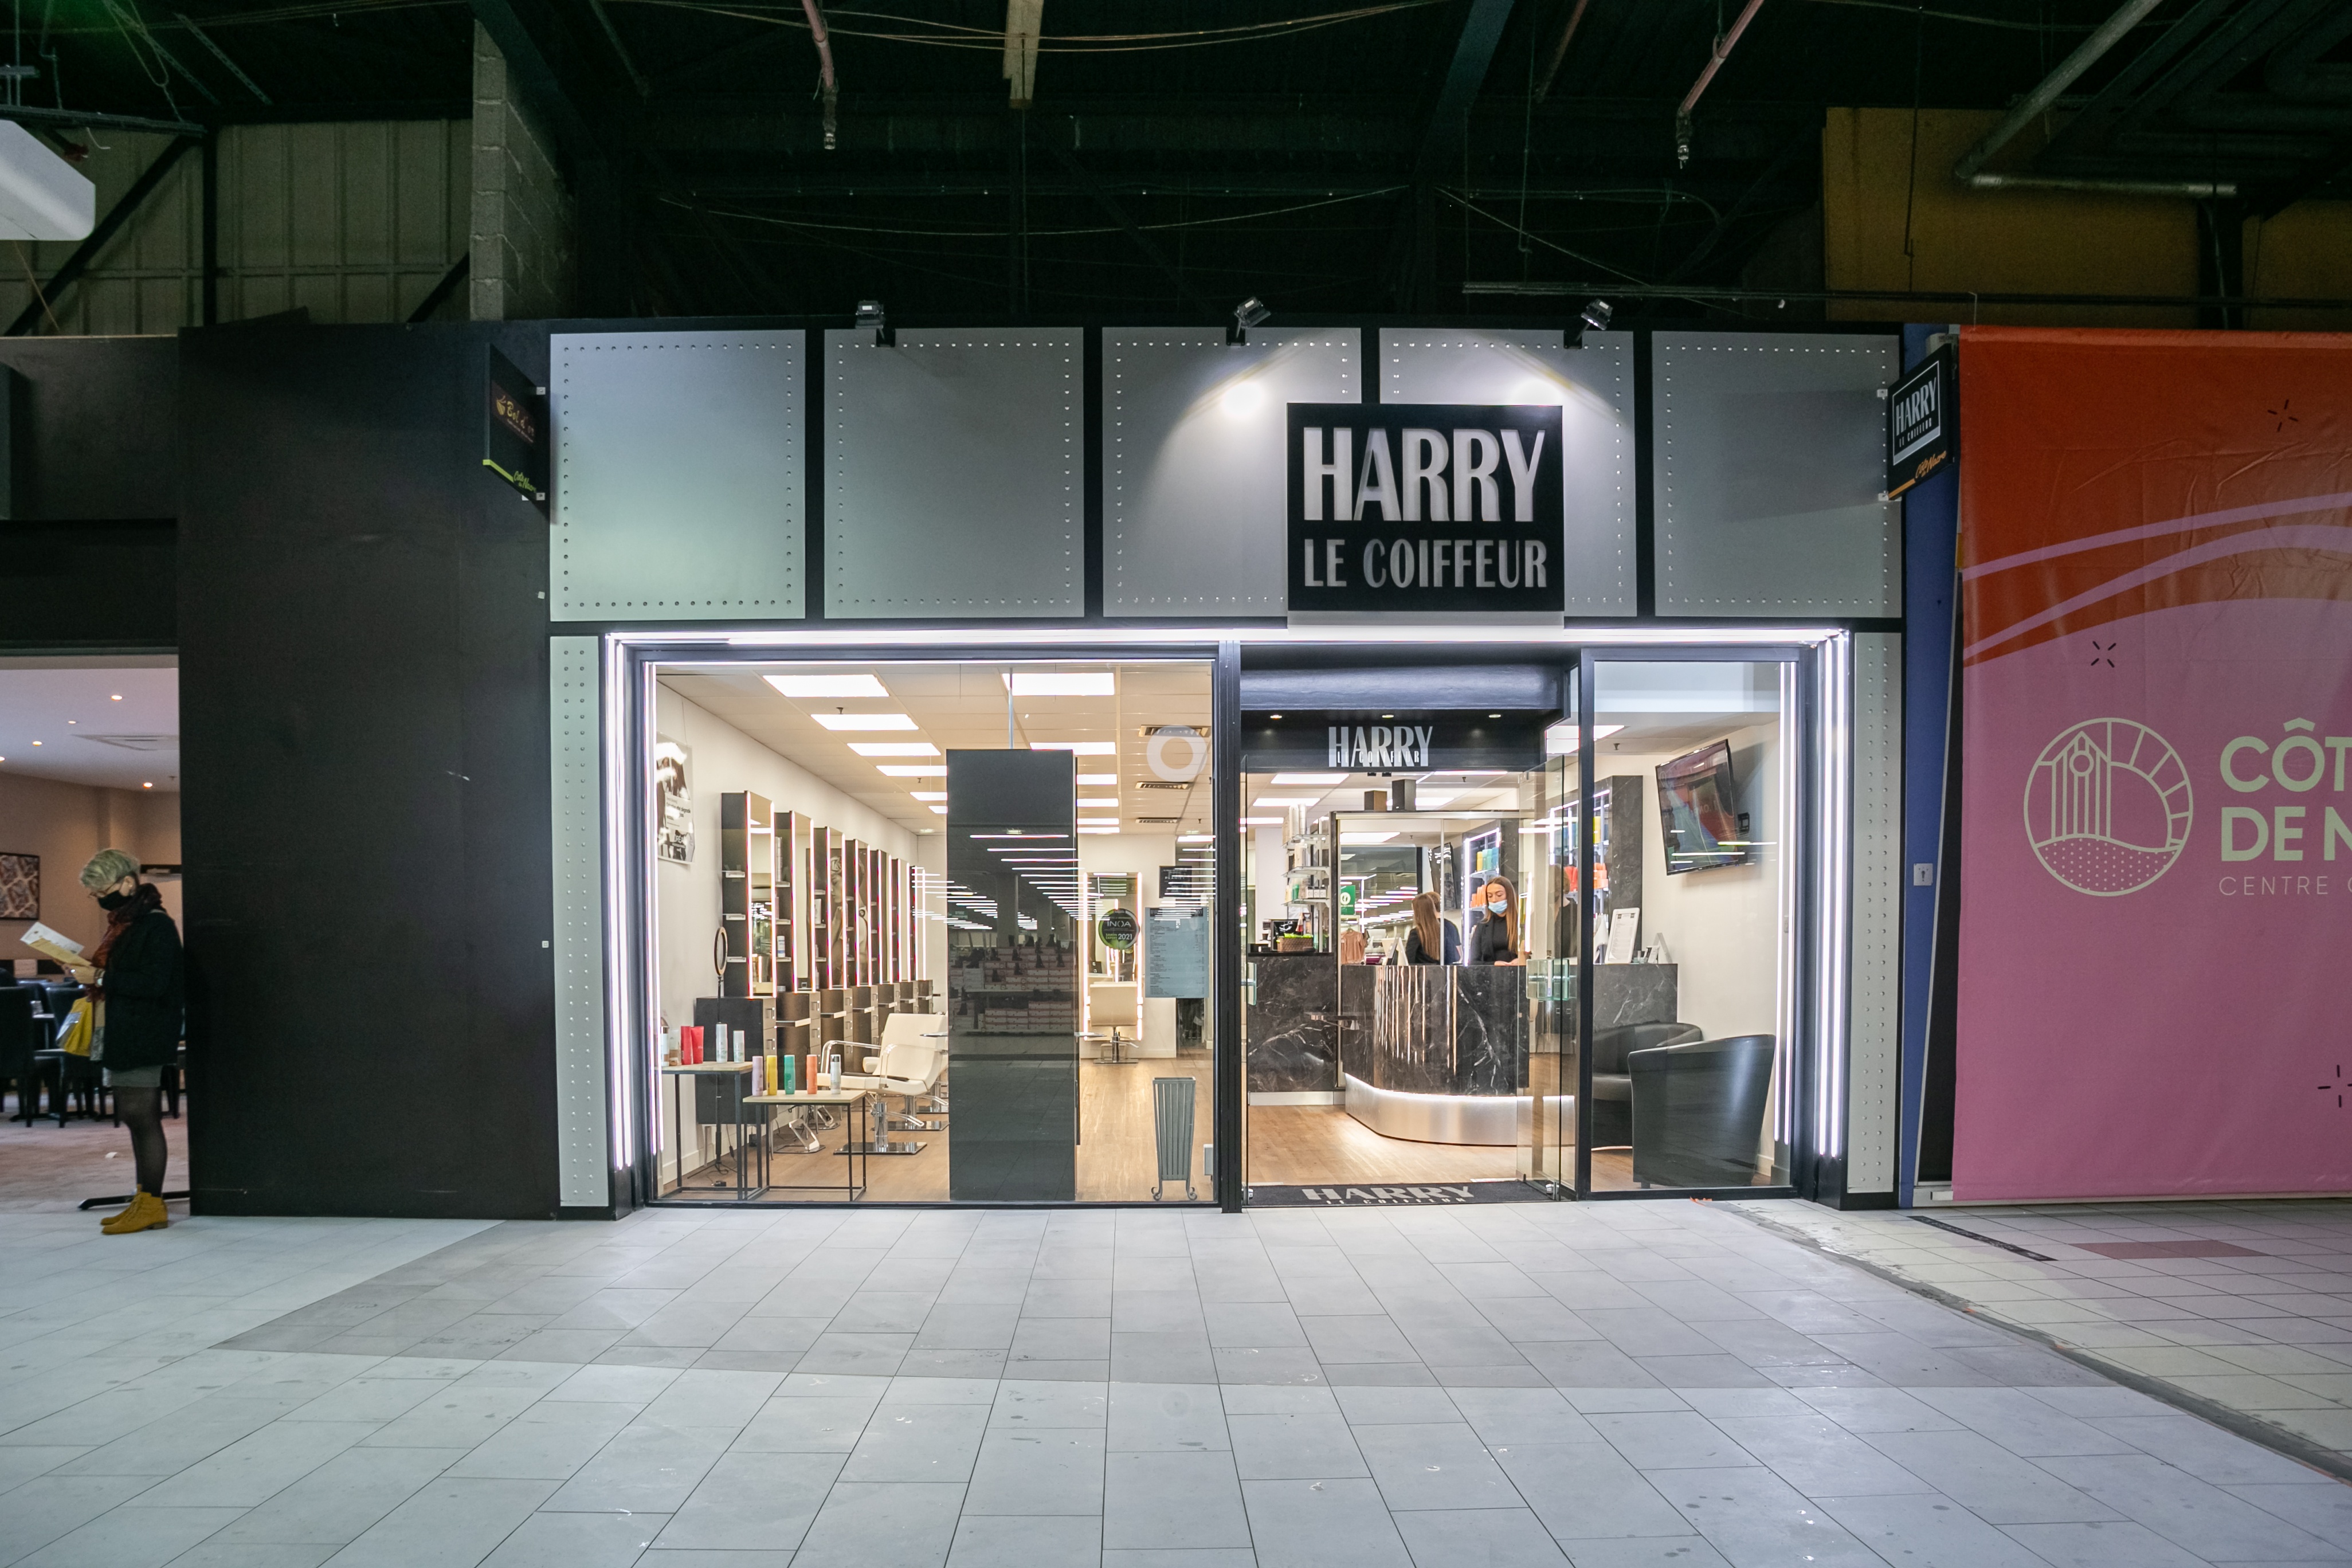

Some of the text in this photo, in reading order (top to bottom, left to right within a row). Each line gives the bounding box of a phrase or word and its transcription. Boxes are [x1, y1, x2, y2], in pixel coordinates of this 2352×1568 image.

[1896, 377, 1937, 436] HARRY
[1907, 417, 1932, 442] COIFFEUR
[1303, 426, 1546, 522] HARRY
[1304, 538, 1547, 589] LE COIFFEUR
[1328, 726, 1433, 767] HARRY
[1359, 750, 1420, 764] COIFFEUR
[2221, 806, 2306, 862] DE
[2218, 876, 2329, 896] CENTRE
[1302, 1186, 1475, 1200] HARRY
